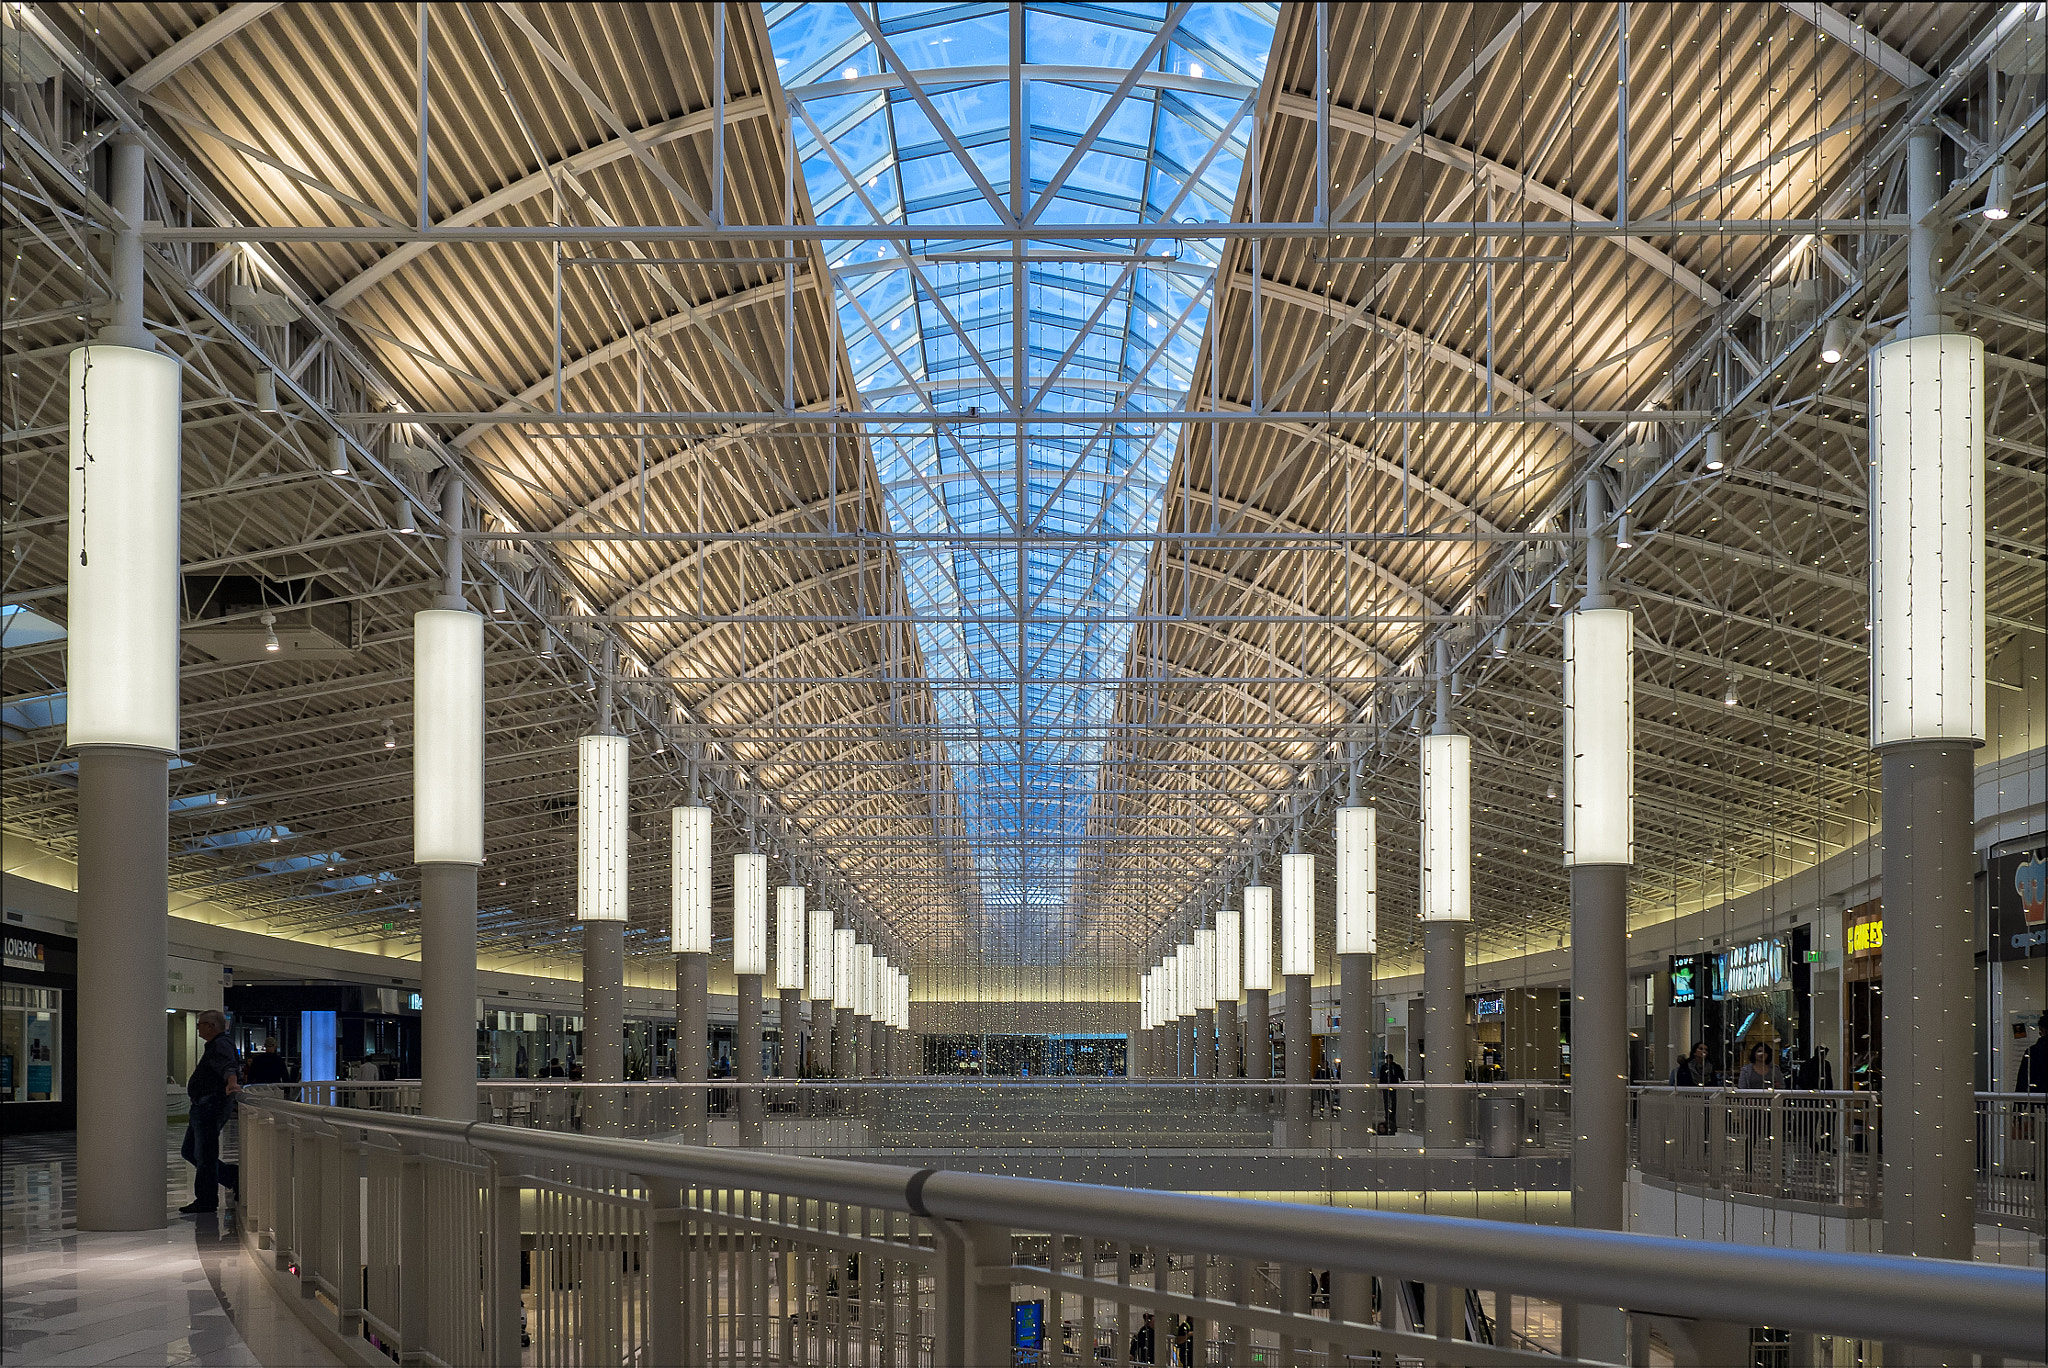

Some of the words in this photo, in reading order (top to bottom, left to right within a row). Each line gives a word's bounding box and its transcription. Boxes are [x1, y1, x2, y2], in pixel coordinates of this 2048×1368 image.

[1674, 957, 1694, 967] LOVE
[1730, 946, 1747, 968] LOVE
[1749, 940, 1768, 964] FROM
[1728, 961, 1769, 993] MINNESOTA
[1673, 993, 1695, 1004] FROM
